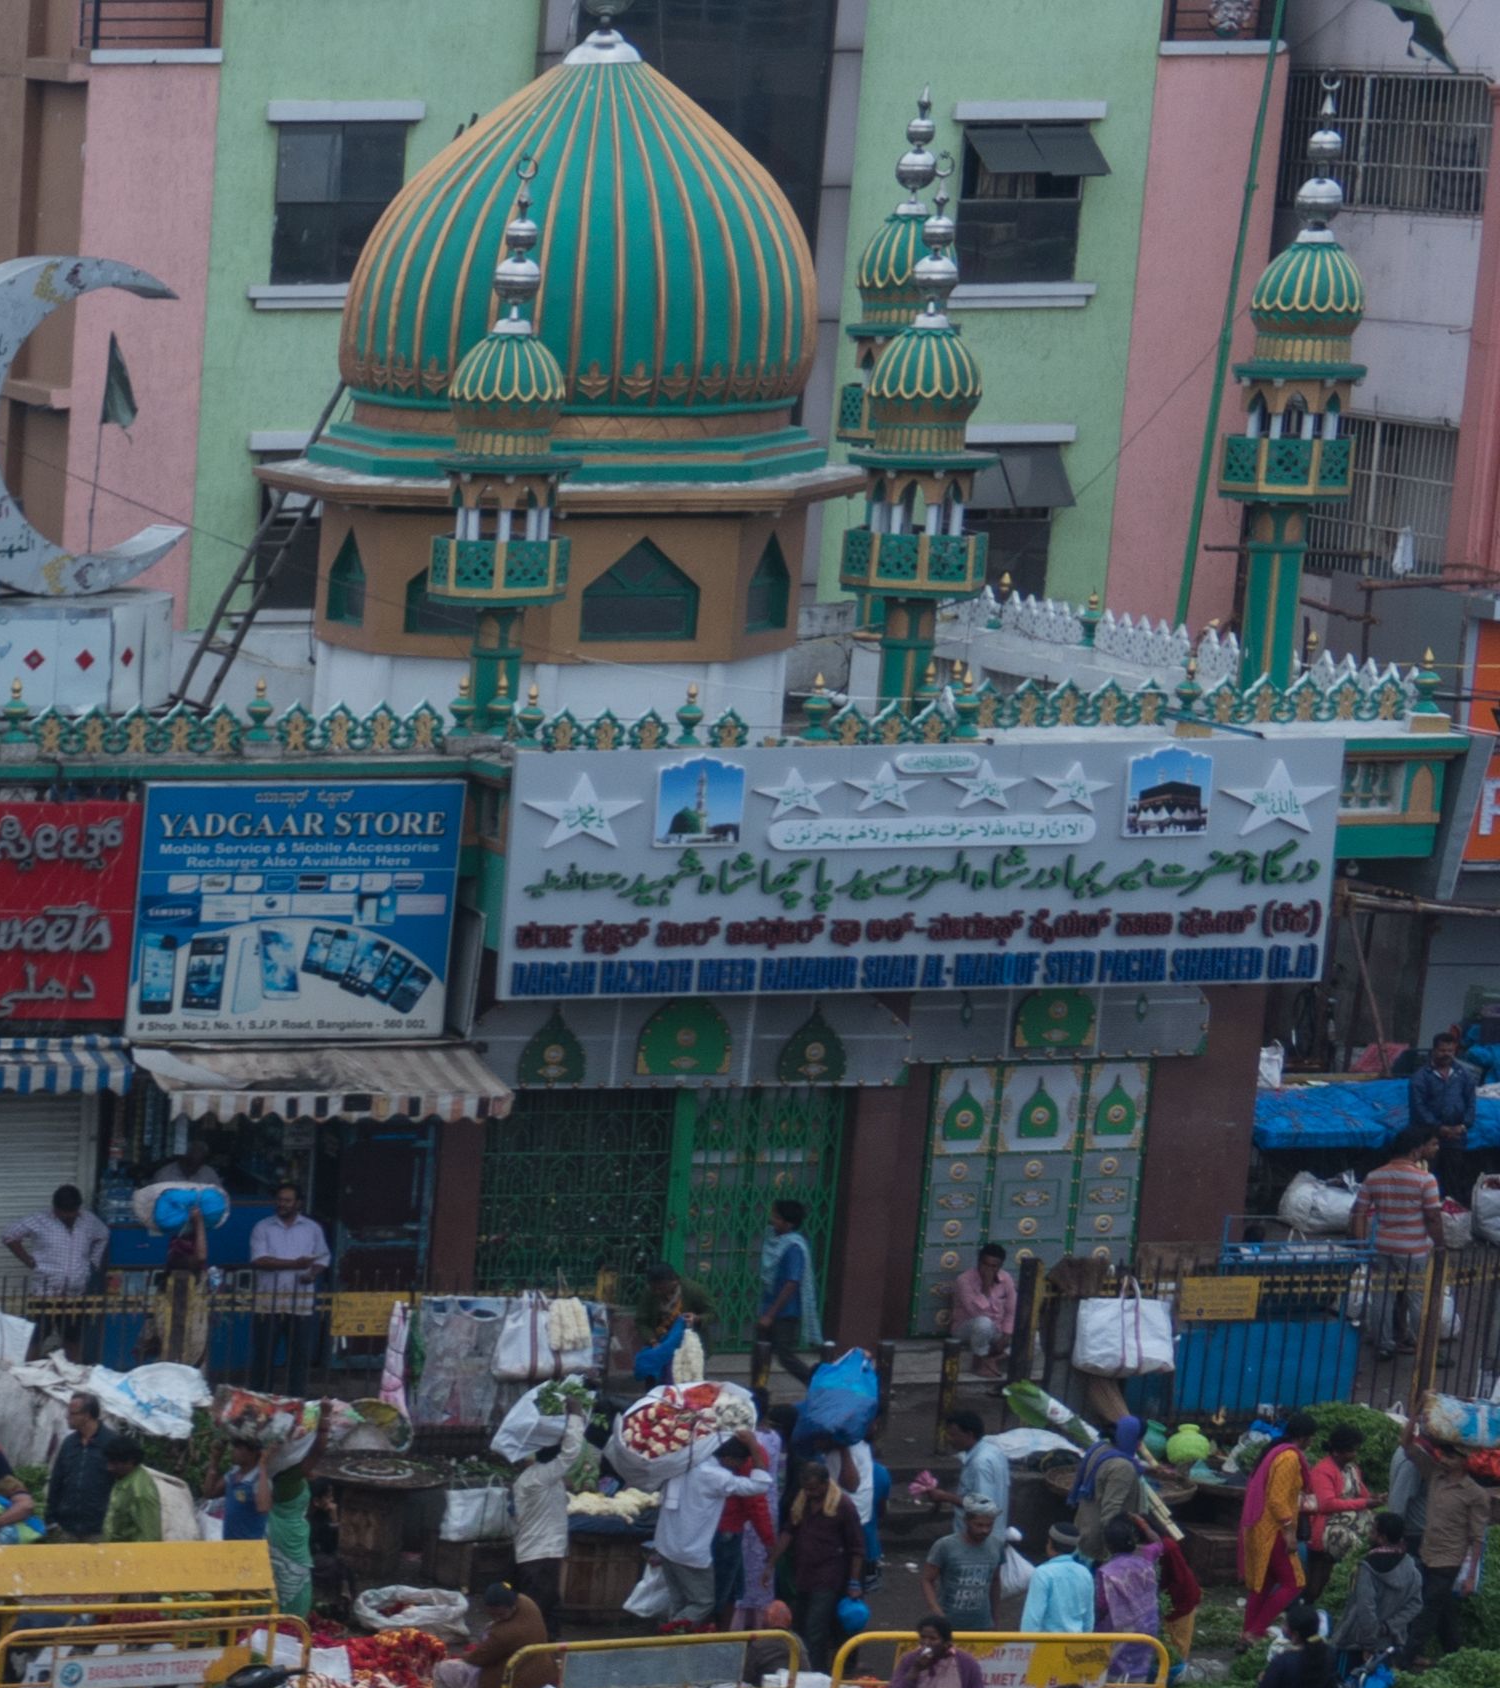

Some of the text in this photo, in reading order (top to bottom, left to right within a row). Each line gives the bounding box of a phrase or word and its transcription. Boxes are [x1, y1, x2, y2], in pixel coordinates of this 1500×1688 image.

[159, 811, 447, 838] YADGAAR STORE
[159, 840, 441, 855] Mobile Service & Mobile Accessories
[186, 853, 412, 871] Recharge Also Available Here
[510, 960, 598, 996] DARGAH
[599, 957, 695, 994] HAZRATH
[696, 956, 757, 993] MEER
[759, 954, 858, 991] BAHADUR
[861, 953, 918, 989] SHAH
[1043, 949, 1097, 985] SYED
[1098, 948, 1168, 983] PACHA
[1169, 946, 1265, 982] SHAHEED
[316, 1017, 374, 1033] Bangalore
[86, 1662, 169, 1682] BANGALORE CITY
